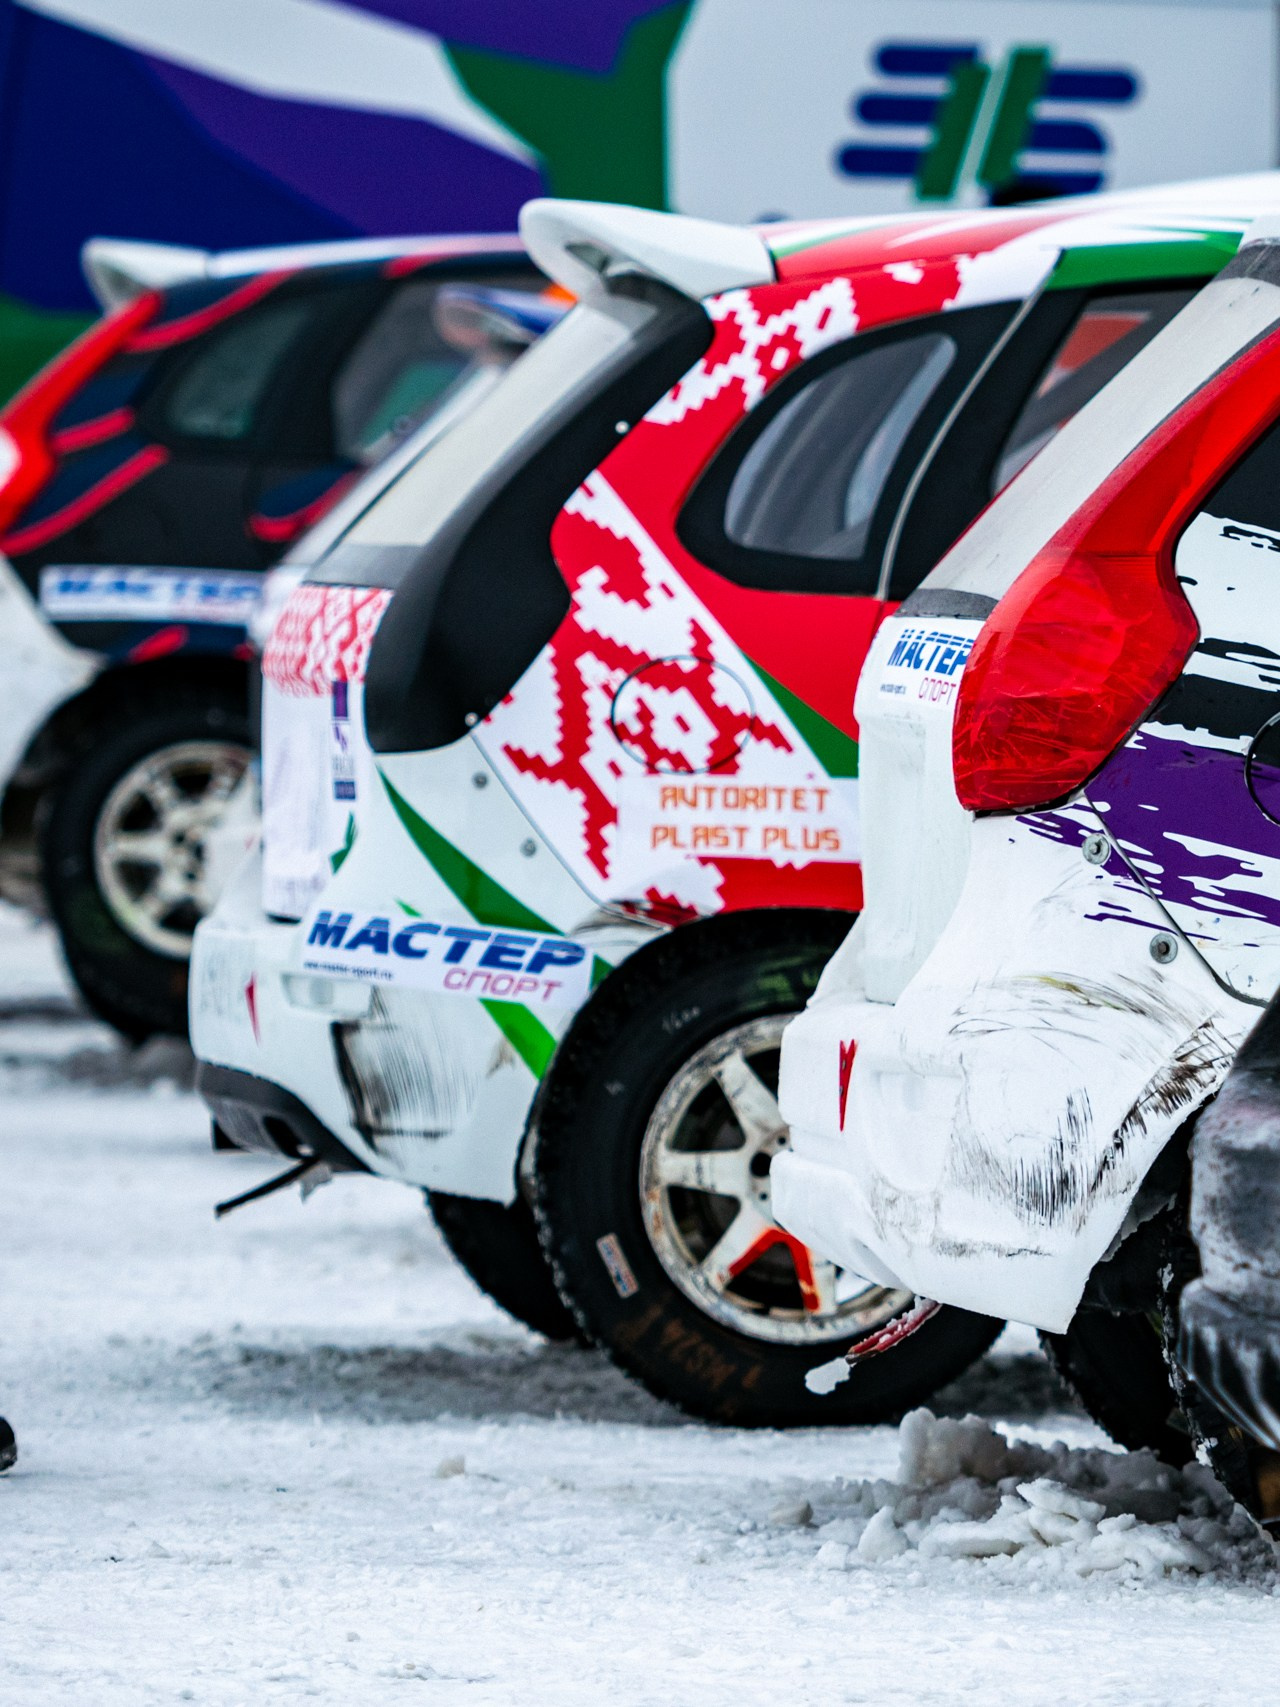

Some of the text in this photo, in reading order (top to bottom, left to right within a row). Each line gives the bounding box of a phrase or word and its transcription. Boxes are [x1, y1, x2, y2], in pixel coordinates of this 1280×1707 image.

[886, 628, 976, 677] МАСТЕР
[917, 676, 957, 706] СПОРТ
[650, 824, 842, 851] PLAST PLUS
[306, 910, 586, 975] МАСТЕР
[442, 967, 563, 1001] СПОРТ
